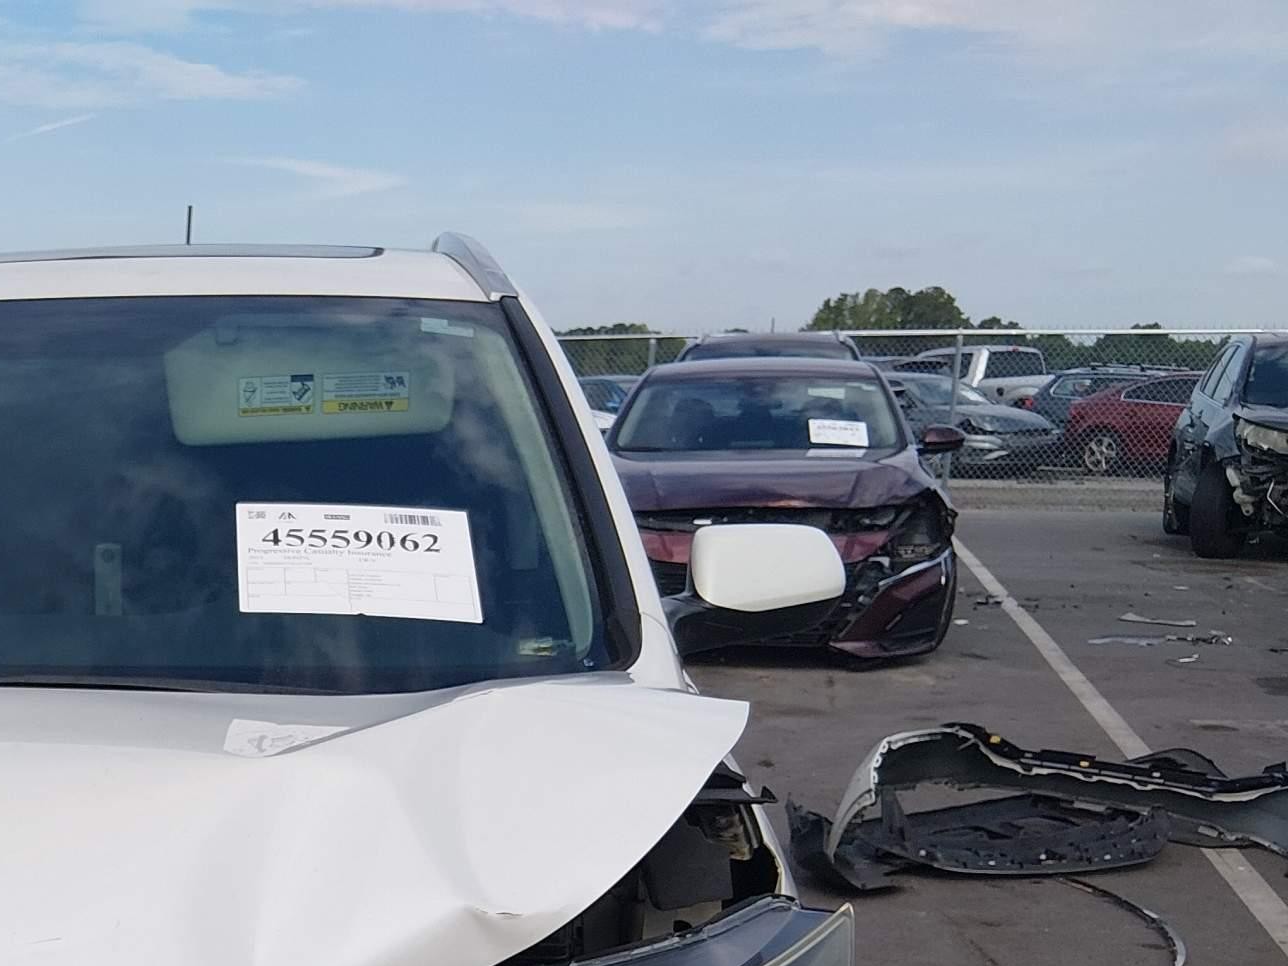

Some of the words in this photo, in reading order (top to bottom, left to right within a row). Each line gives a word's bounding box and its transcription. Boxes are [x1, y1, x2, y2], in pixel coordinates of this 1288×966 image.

[338, 401, 383, 412] WARNING
[261, 528, 441, 554] 45559062
[247, 547, 302, 556] Progressive
